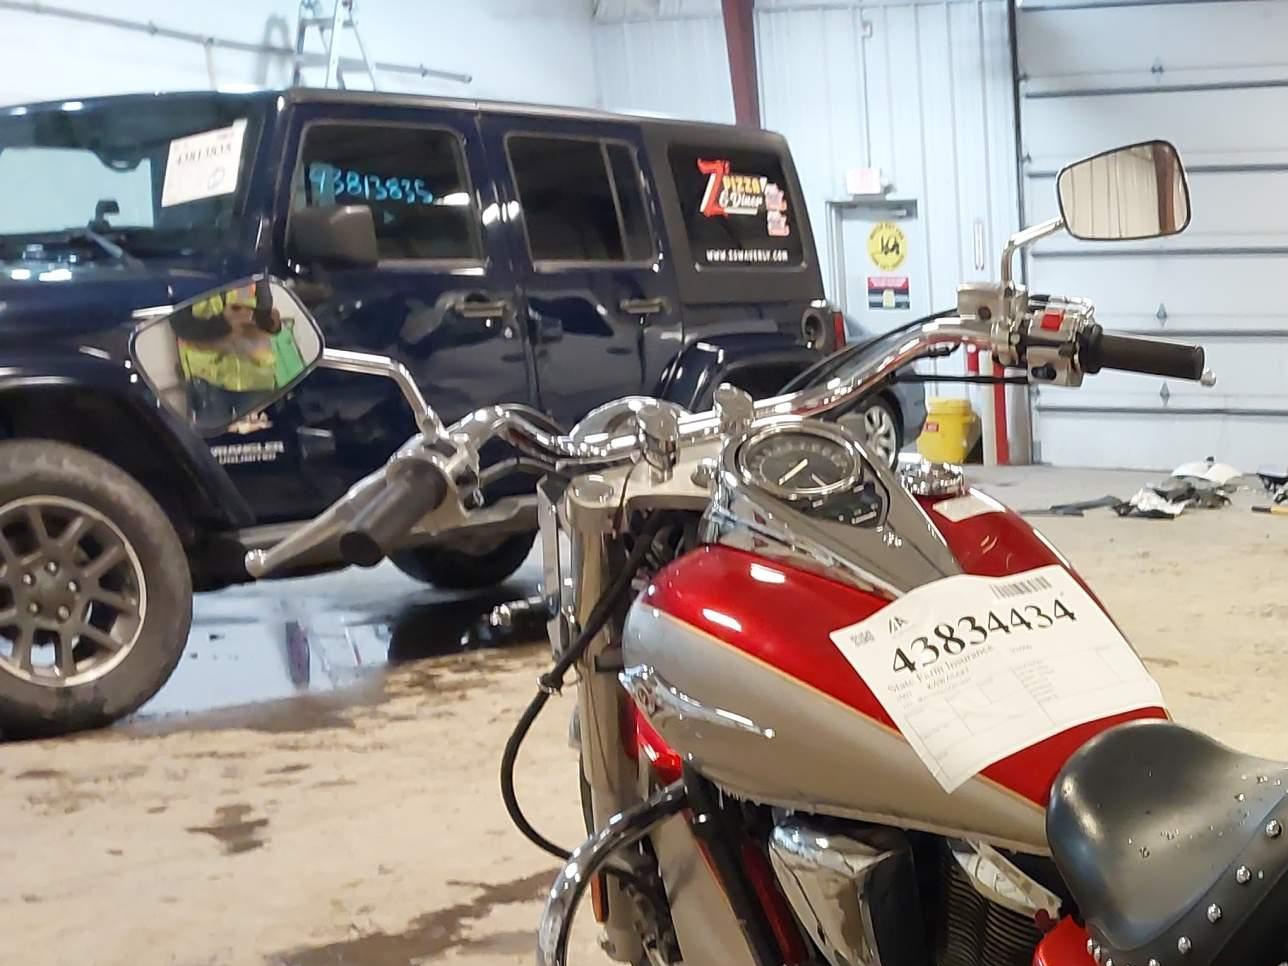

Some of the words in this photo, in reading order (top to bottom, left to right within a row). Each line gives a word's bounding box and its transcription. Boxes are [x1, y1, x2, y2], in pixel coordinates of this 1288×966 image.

[722, 176, 760, 195] PIZZA
[210, 441, 284, 458] WRANGLER
[892, 599, 1077, 674] 43834434
